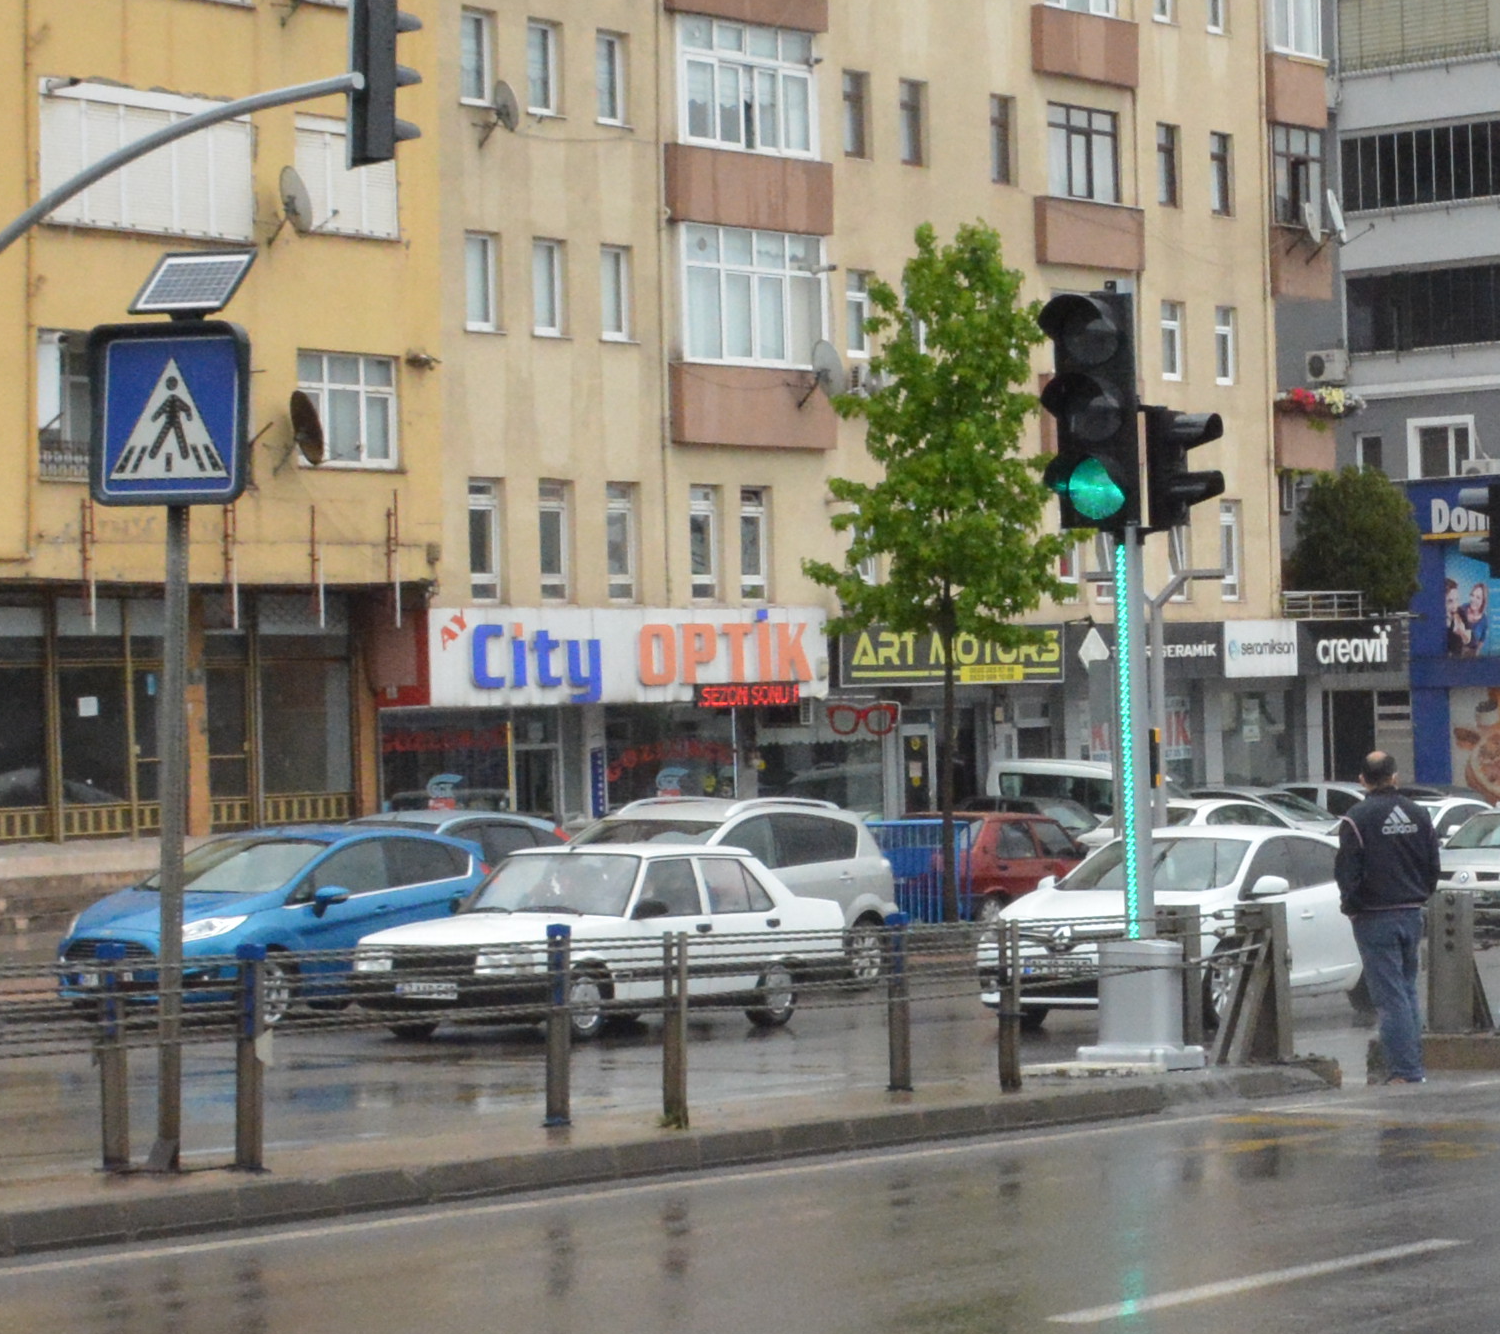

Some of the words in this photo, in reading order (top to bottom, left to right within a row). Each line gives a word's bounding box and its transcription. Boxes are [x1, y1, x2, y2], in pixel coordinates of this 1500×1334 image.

[440, 609, 468, 650] AY
[471, 623, 600, 704] City
[638, 609, 813, 686] OPTİK
[852, 632, 916, 665] ART
[1316, 624, 1392, 664] creavit
[1382, 823, 1418, 835] adidas
